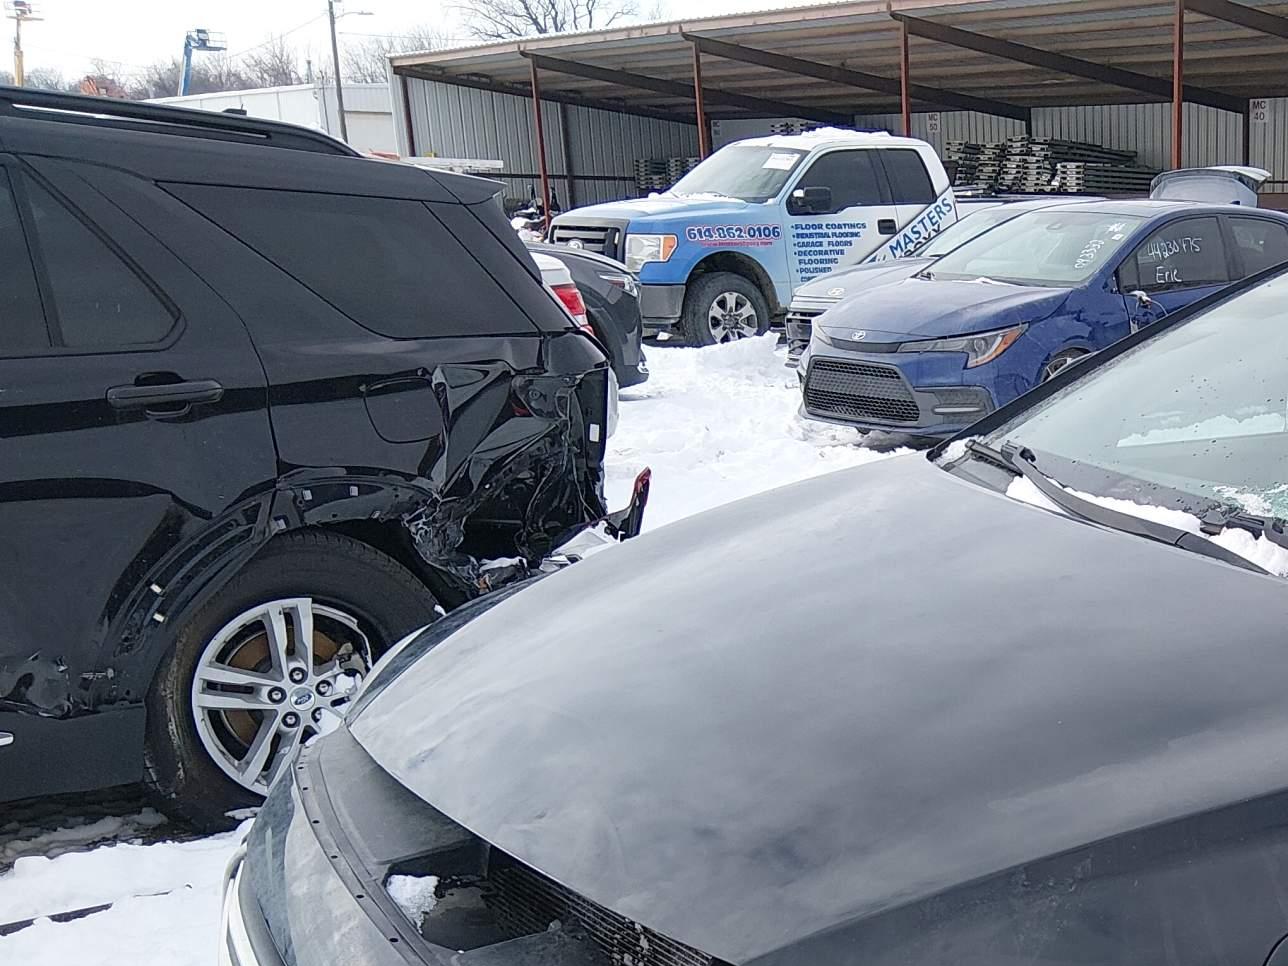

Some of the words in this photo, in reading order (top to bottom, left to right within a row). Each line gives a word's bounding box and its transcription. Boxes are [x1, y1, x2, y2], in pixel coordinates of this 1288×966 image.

[794, 223, 824, 231] FLOOR
[825, 222, 867, 230] COATINGS
[889, 198, 952, 258] MASTERS
[686, 225, 781, 241] 614.862.0106
[796, 240, 824, 248] GARAGE
[797, 249, 845, 257] DECORATIVE
[798, 257, 839, 265] FLOORING
